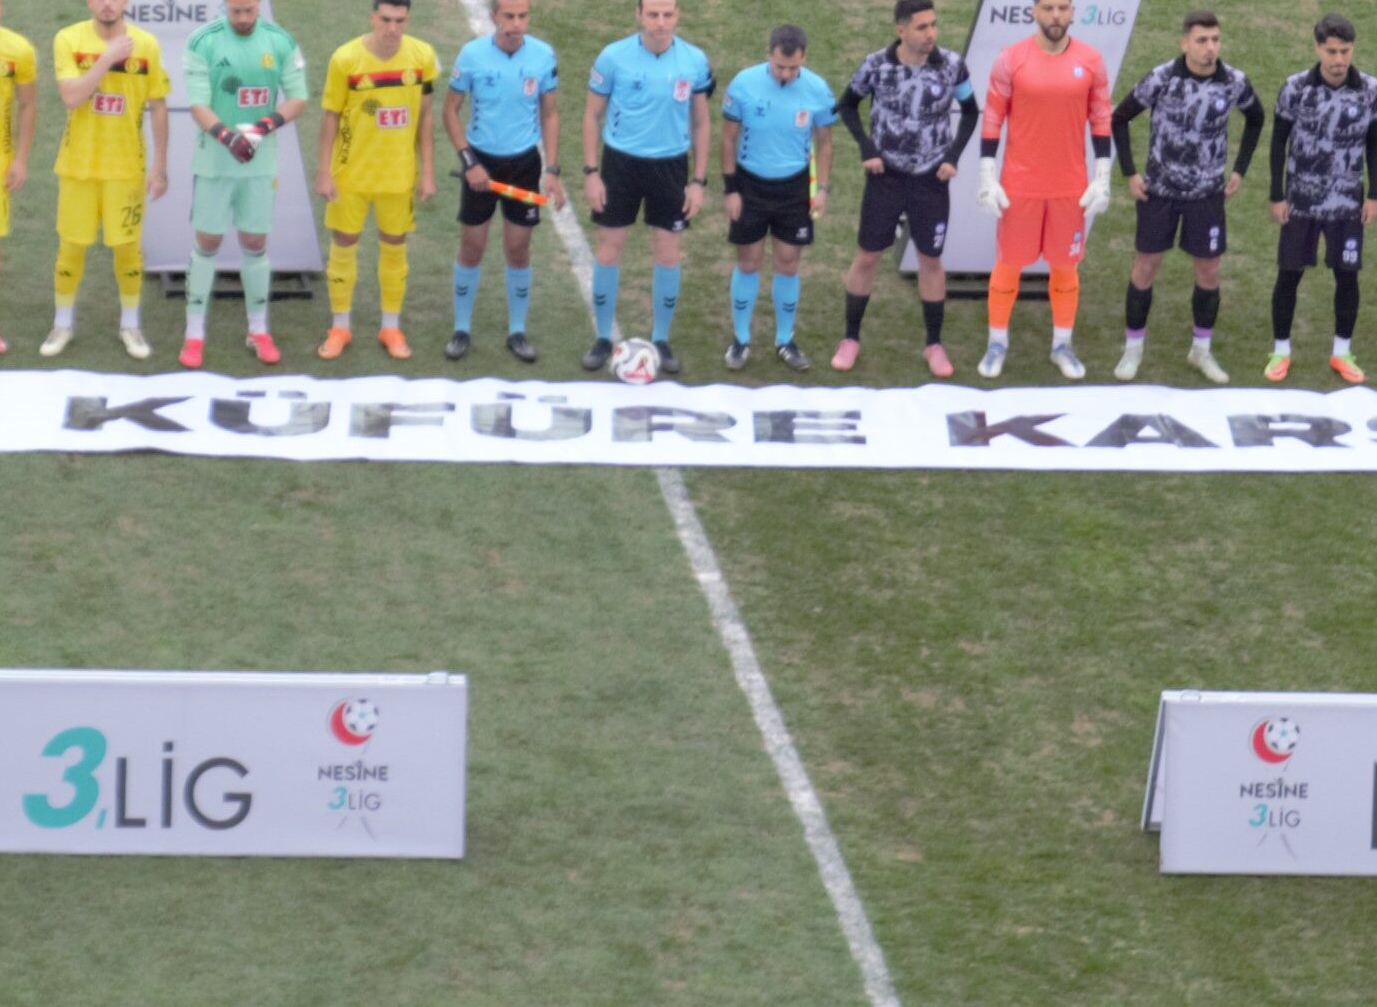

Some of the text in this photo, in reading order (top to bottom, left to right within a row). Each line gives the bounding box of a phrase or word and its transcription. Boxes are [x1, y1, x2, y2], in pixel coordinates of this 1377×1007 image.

[121, 204, 142, 229] 26
[60, 389, 869, 445] KÜFÜRE
[318, 760, 389, 782] NESİNE
[1239, 777, 1309, 799] NESİNE
